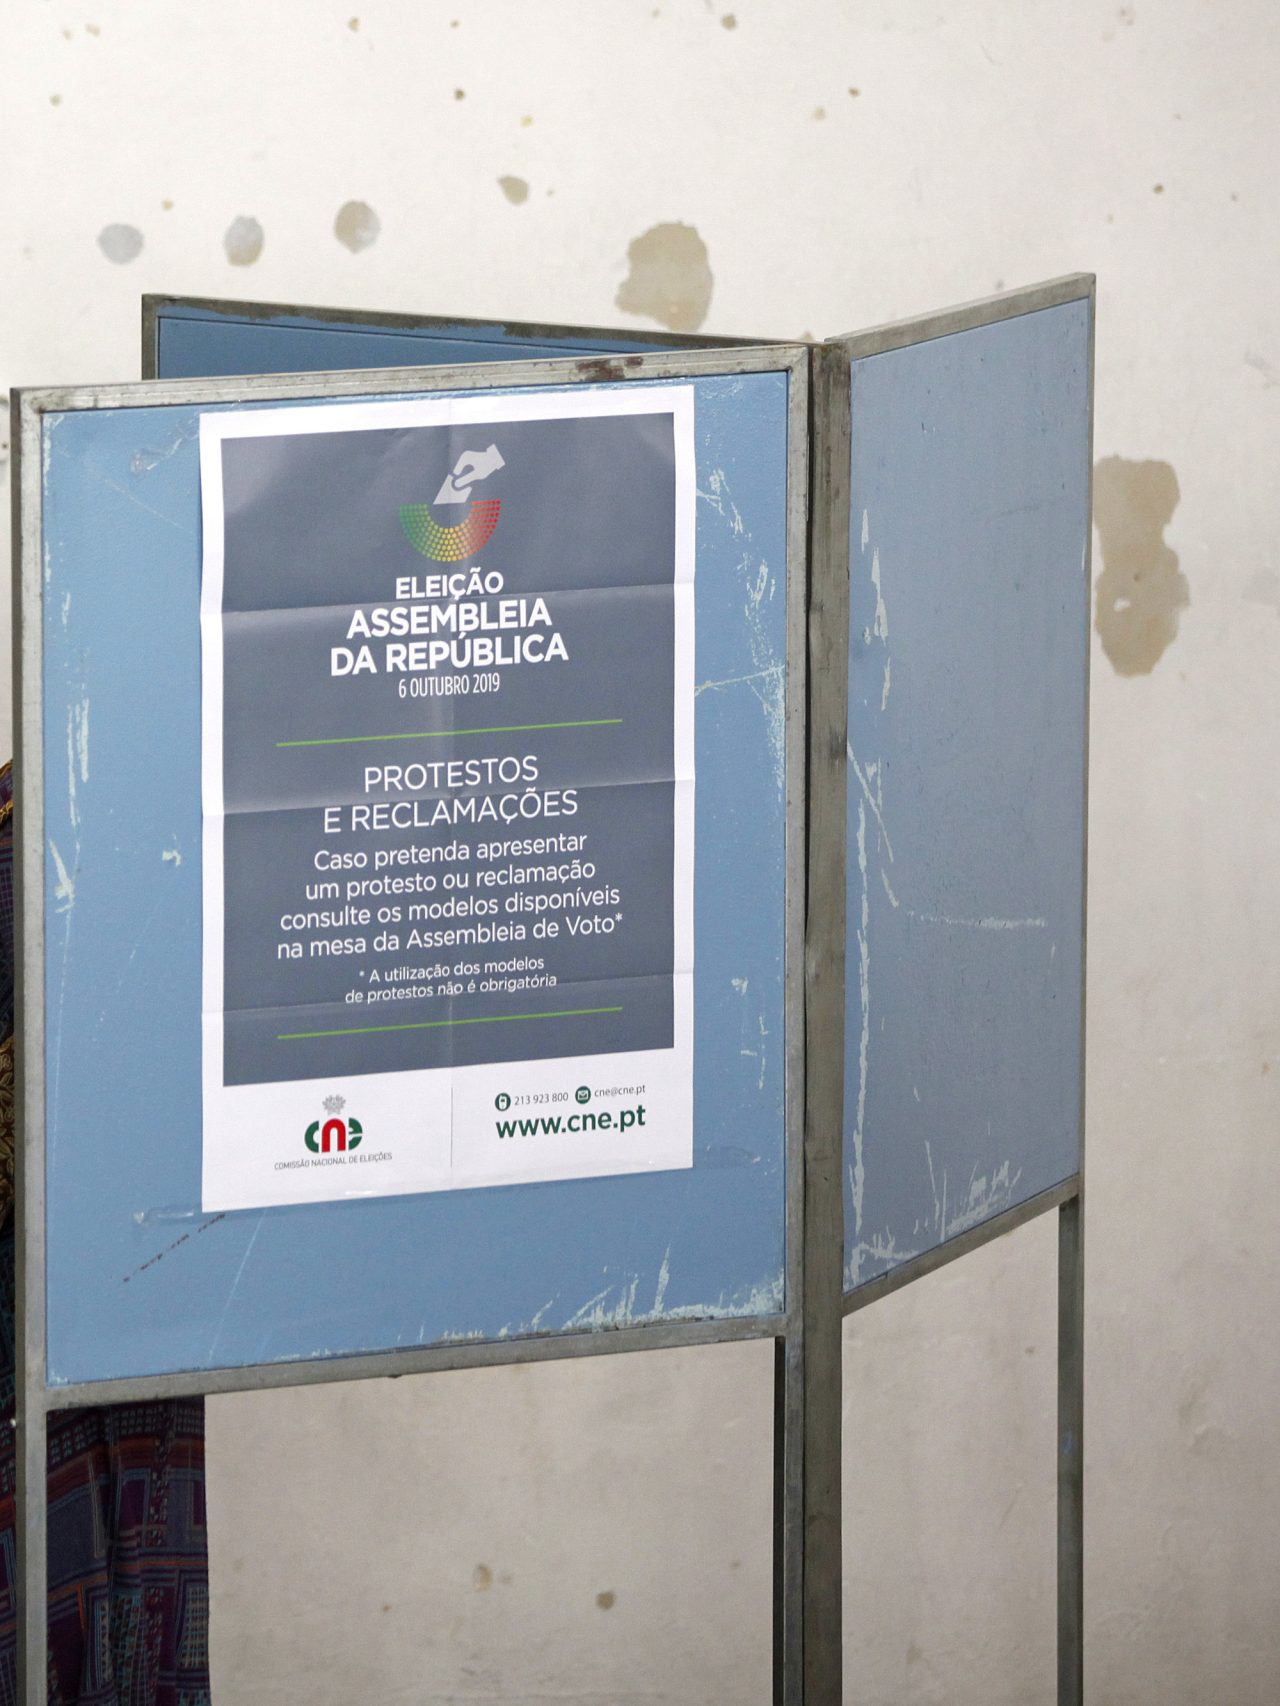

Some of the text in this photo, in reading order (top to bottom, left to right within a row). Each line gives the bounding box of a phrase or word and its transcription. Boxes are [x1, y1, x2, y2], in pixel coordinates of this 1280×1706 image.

[395, 567, 504, 600] ELEIÇÃO
[346, 597, 553, 639] ASSEMBLEIA
[330, 632, 570, 677] DA REPÚBLICA
[398, 672, 501, 699] 6 OUTUBRO 2019
[364, 755, 539, 793] PROTESTOS
[324, 787, 578, 834] E RECLAMAÇÕES
[313, 832, 588, 871] Caso pretenda apresentar
[305, 858, 596, 902] um protesto ou reclamação
[280, 884, 620, 931] consulte os modelos disponíveis
[277, 942, 303, 960] na
[310, 937, 367, 957] mesa
[373, 930, 400, 952] da
[406, 920, 526, 950] Assembleia
[532, 917, 560, 939] de
[368, 968, 381, 984] A
[384, 963, 451, 982] utilização
[453, 961, 481, 976] dos
[484, 955, 545, 974] modelos
[345, 973, 557, 1005] de protestos não é obrigatória
[514, 1084, 646, 1106] 213 923 800 cne@cne.pt
[495, 1104, 646, 1139] www.cne.pt
[273, 1151, 393, 1171] COMISSÃO NACIONAL DE ELEIÇÕES
